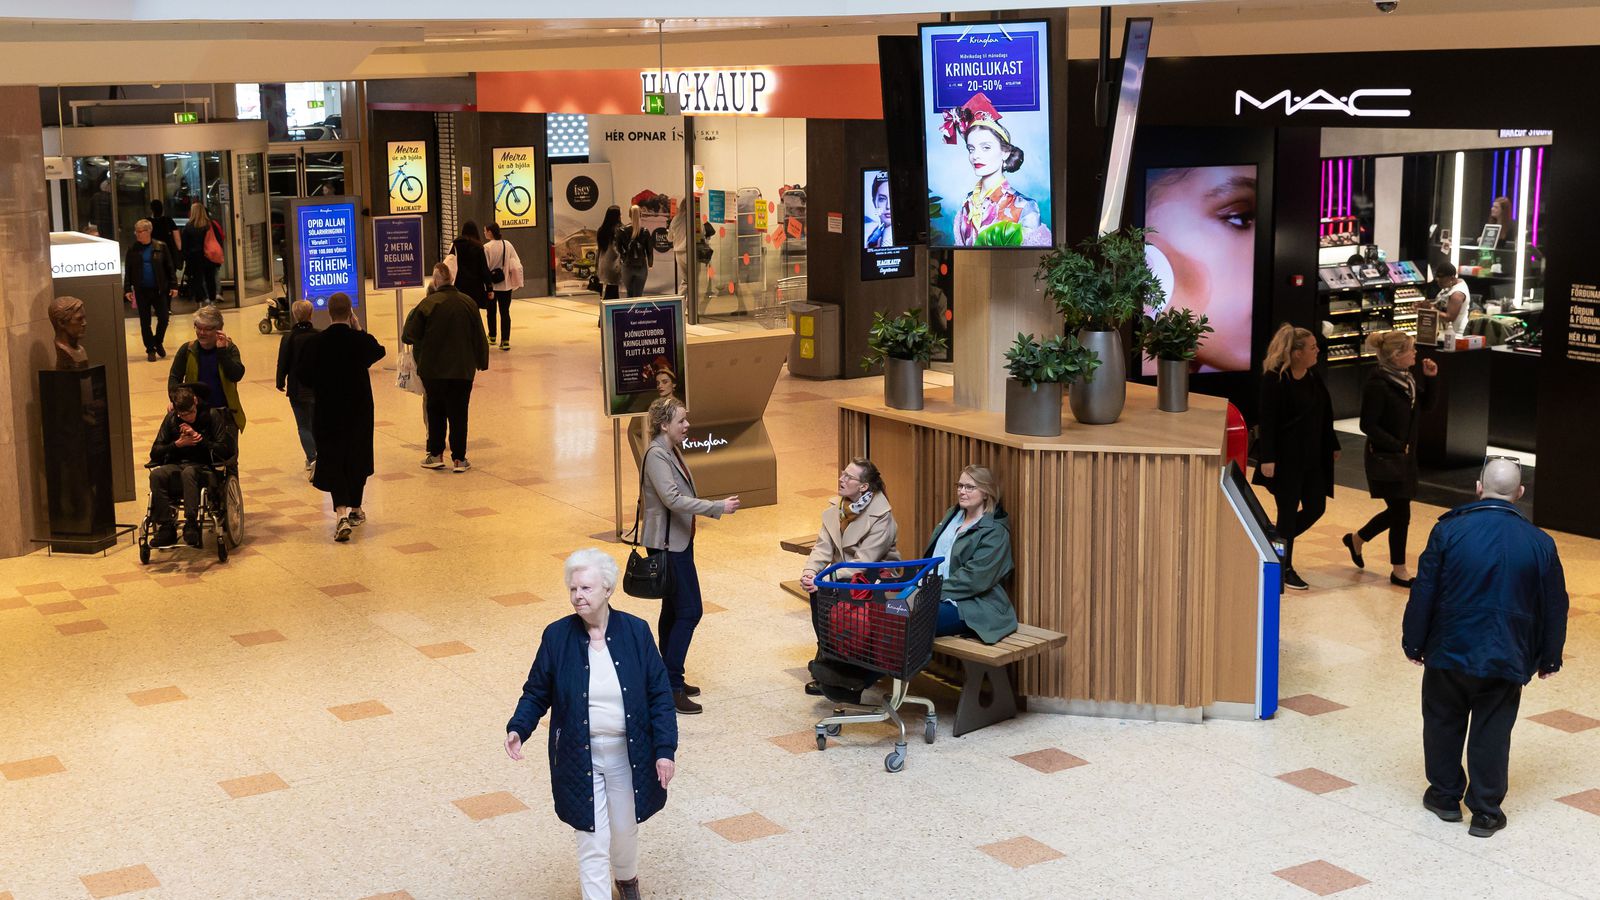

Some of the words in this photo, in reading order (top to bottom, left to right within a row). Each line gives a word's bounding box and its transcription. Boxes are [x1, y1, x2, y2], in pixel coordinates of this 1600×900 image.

[969, 34, 999, 47] Kringlan
[945, 60, 1023, 77] KRINGLUKAST
[968, 80, 1002, 91] 20-50%
[605, 129, 624, 141] HÉR
[628, 132, 666, 141] OPNAR
[395, 145, 419, 154] Meira
[500, 152, 527, 161] Meira
[308, 219, 324, 228] OPIÐ
[325, 218, 346, 227] ALLAN
[384, 244, 389, 252] 2
[390, 242, 413, 251] METRA
[384, 253, 414, 262] REGLUNA
[52, 260, 114, 274] otomaton
[309, 257, 324, 272] FRÍ
[325, 258, 351, 271] HEIM-
[309, 273, 348, 287] SENDING
[624, 328, 664, 338] ÞJÓNUSTUBORÐ
[1582, 334, 1586, 342] &
[623, 339, 659, 347] KRINGLUNNAR
[682, 433, 728, 453] Kringlan
